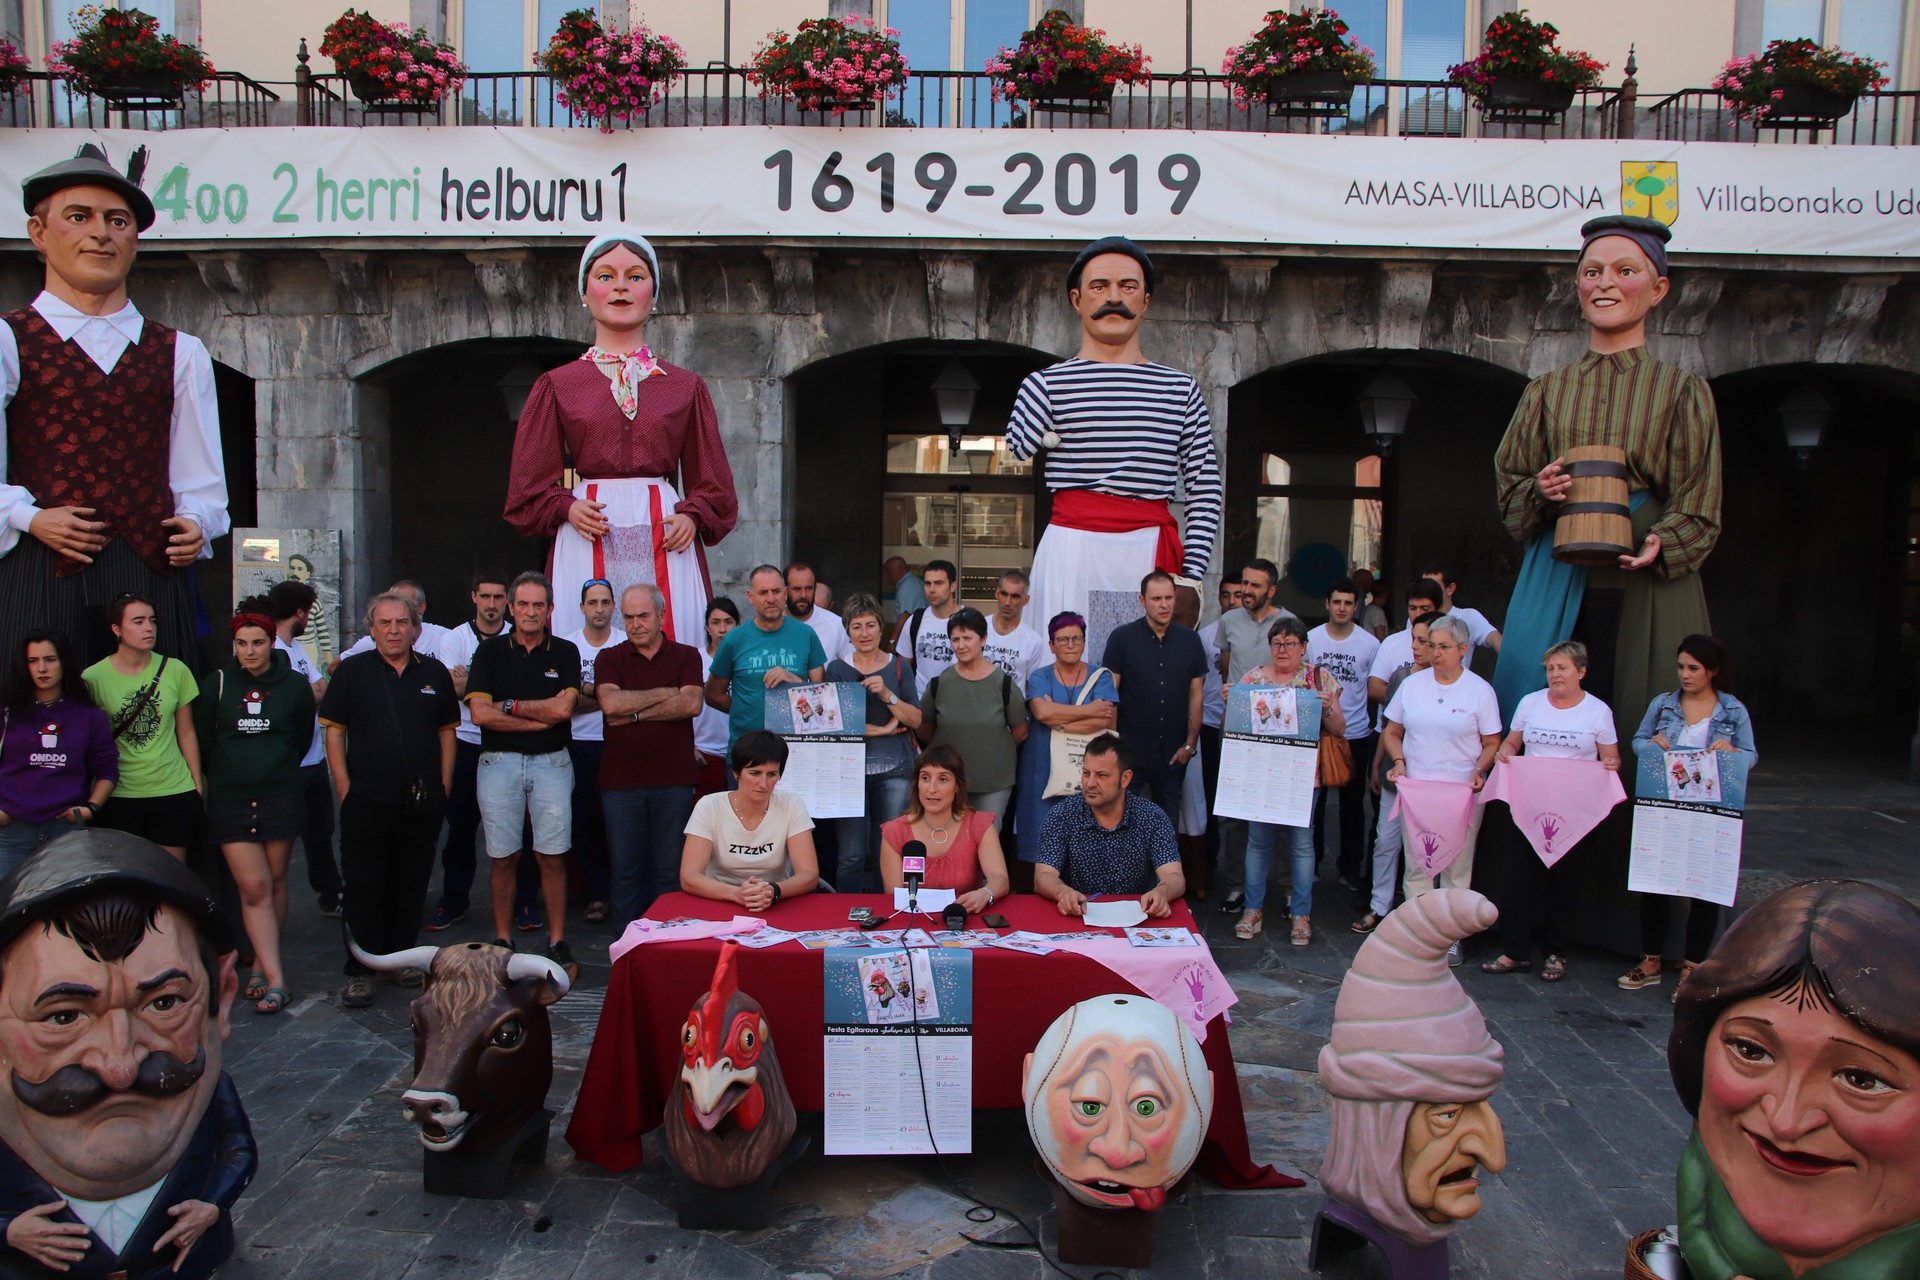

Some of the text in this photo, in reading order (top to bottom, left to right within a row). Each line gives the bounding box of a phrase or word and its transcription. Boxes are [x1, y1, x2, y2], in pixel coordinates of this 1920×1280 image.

[272, 162, 299, 223] 2
[316, 166, 419, 222] herri
[441, 166, 603, 222] helburu
[764, 149, 1201, 216] 1619-2019
[1344, 180, 1605, 210] AMASA-VILLABONA
[1697, 186, 1920, 215] Villabonako Ud
[237, 718, 271, 727] ONDDO
[30, 753, 67, 762] ONDDO
[846, 1026, 879, 1034] Egitaraua
